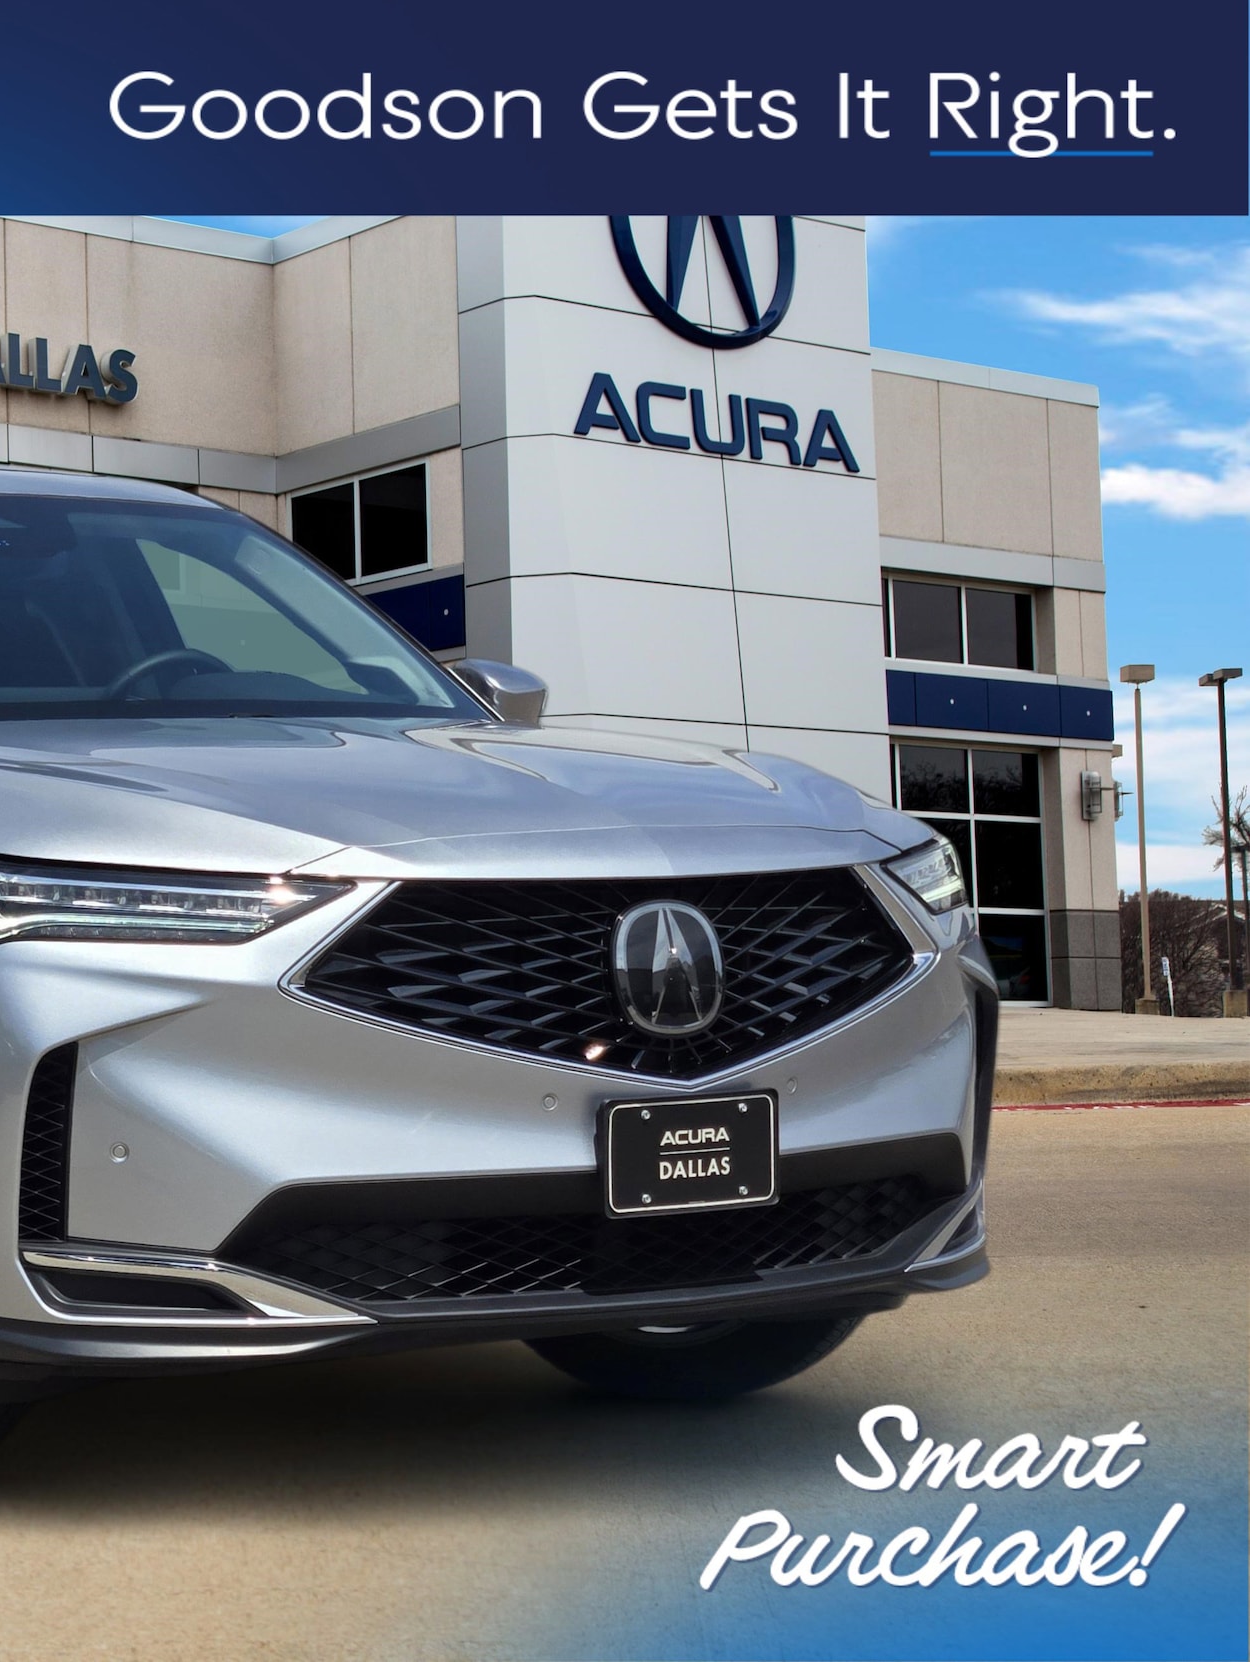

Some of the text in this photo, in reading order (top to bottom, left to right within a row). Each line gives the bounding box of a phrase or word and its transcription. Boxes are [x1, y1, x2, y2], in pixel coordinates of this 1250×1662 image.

[574, 372, 860, 473] ACURA
[660, 1127, 730, 1146] ACURA
[659, 1156, 731, 1180] DALLAS
